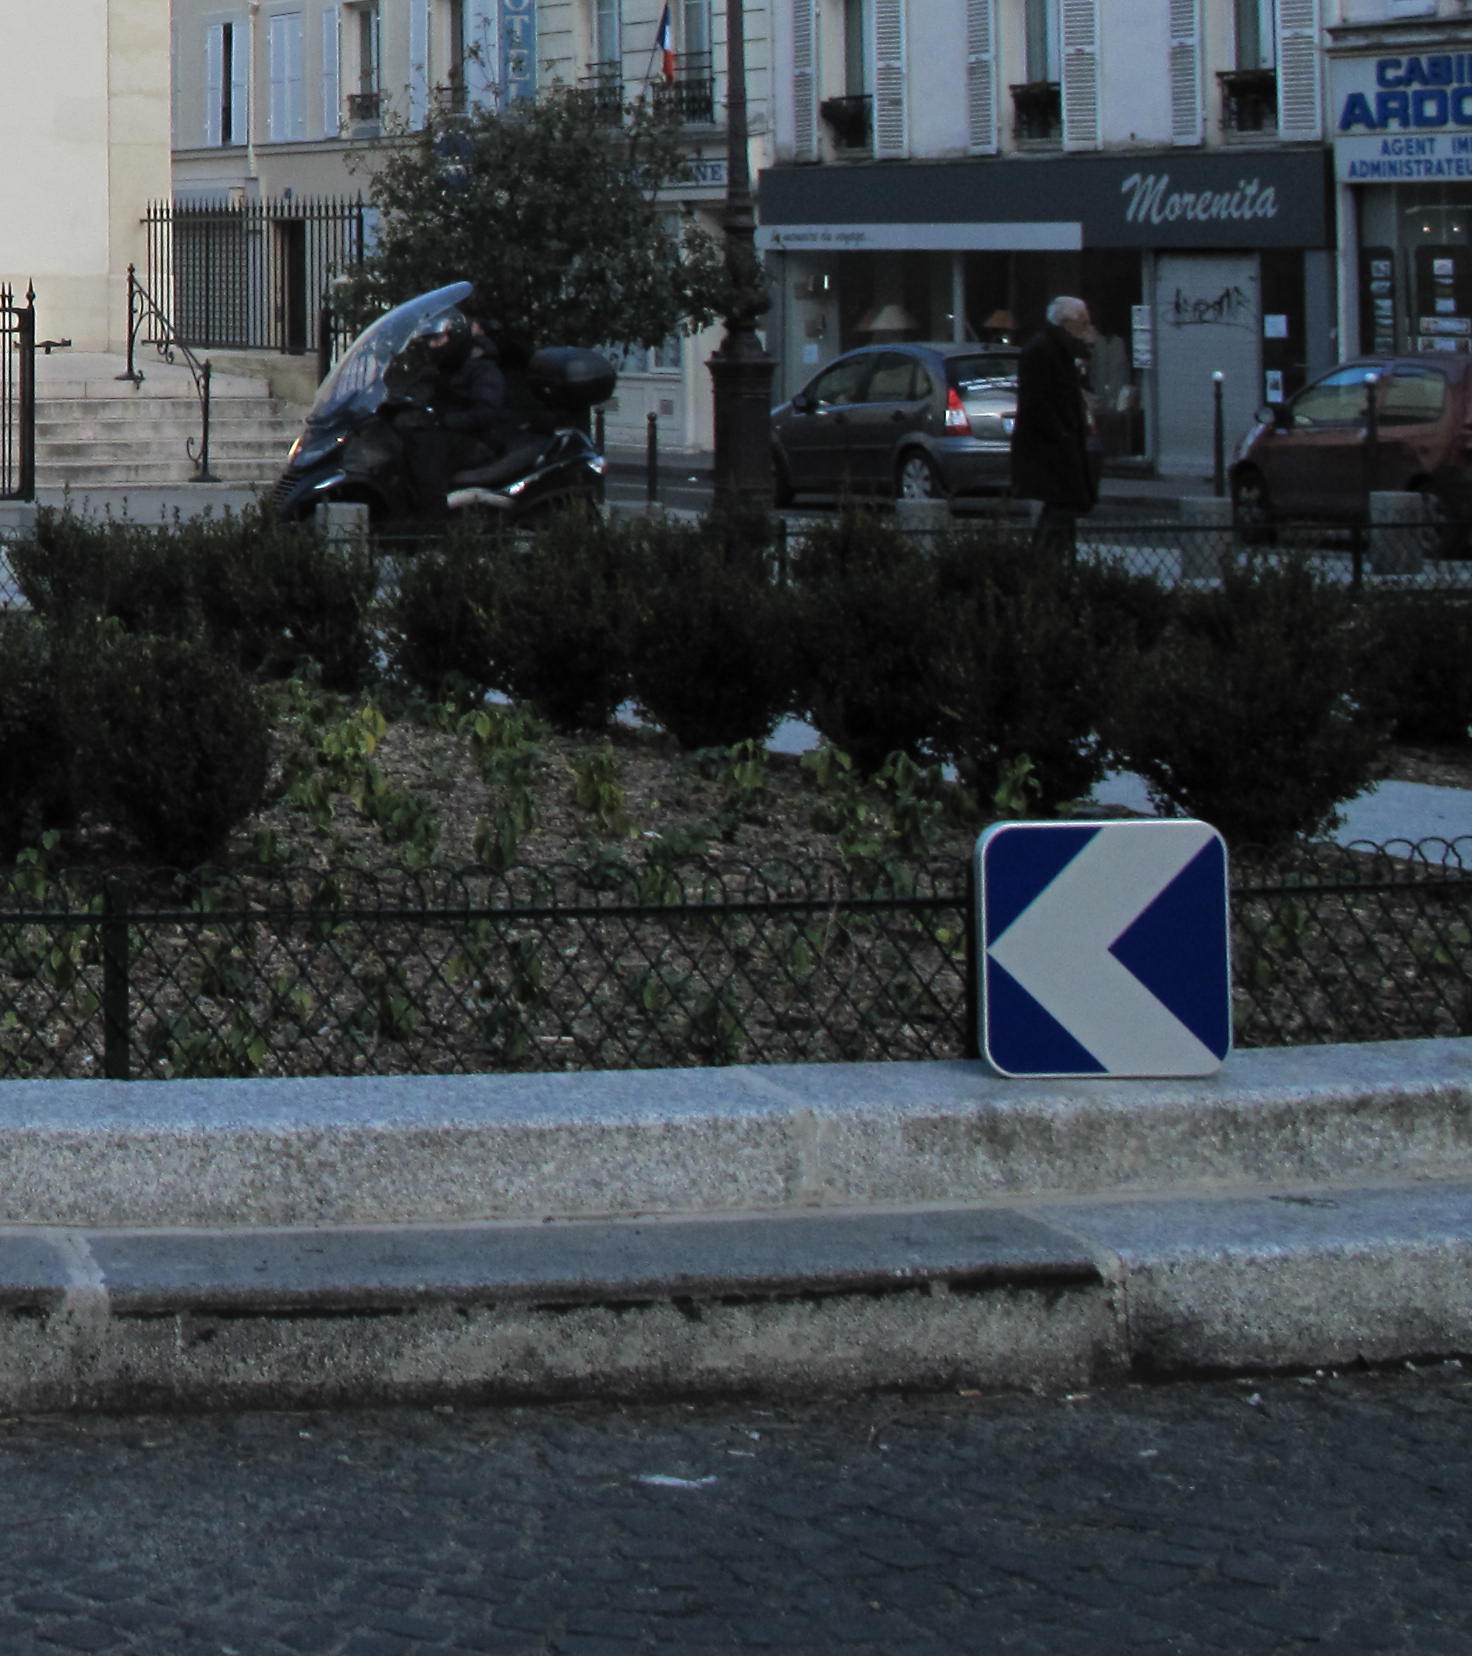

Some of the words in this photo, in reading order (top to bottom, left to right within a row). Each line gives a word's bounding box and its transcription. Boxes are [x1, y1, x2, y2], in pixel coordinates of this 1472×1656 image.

[1375, 53, 1472, 89] CABI
[1380, 136, 1437, 156] AGENT
[1120, 172, 1279, 225] Morenita
